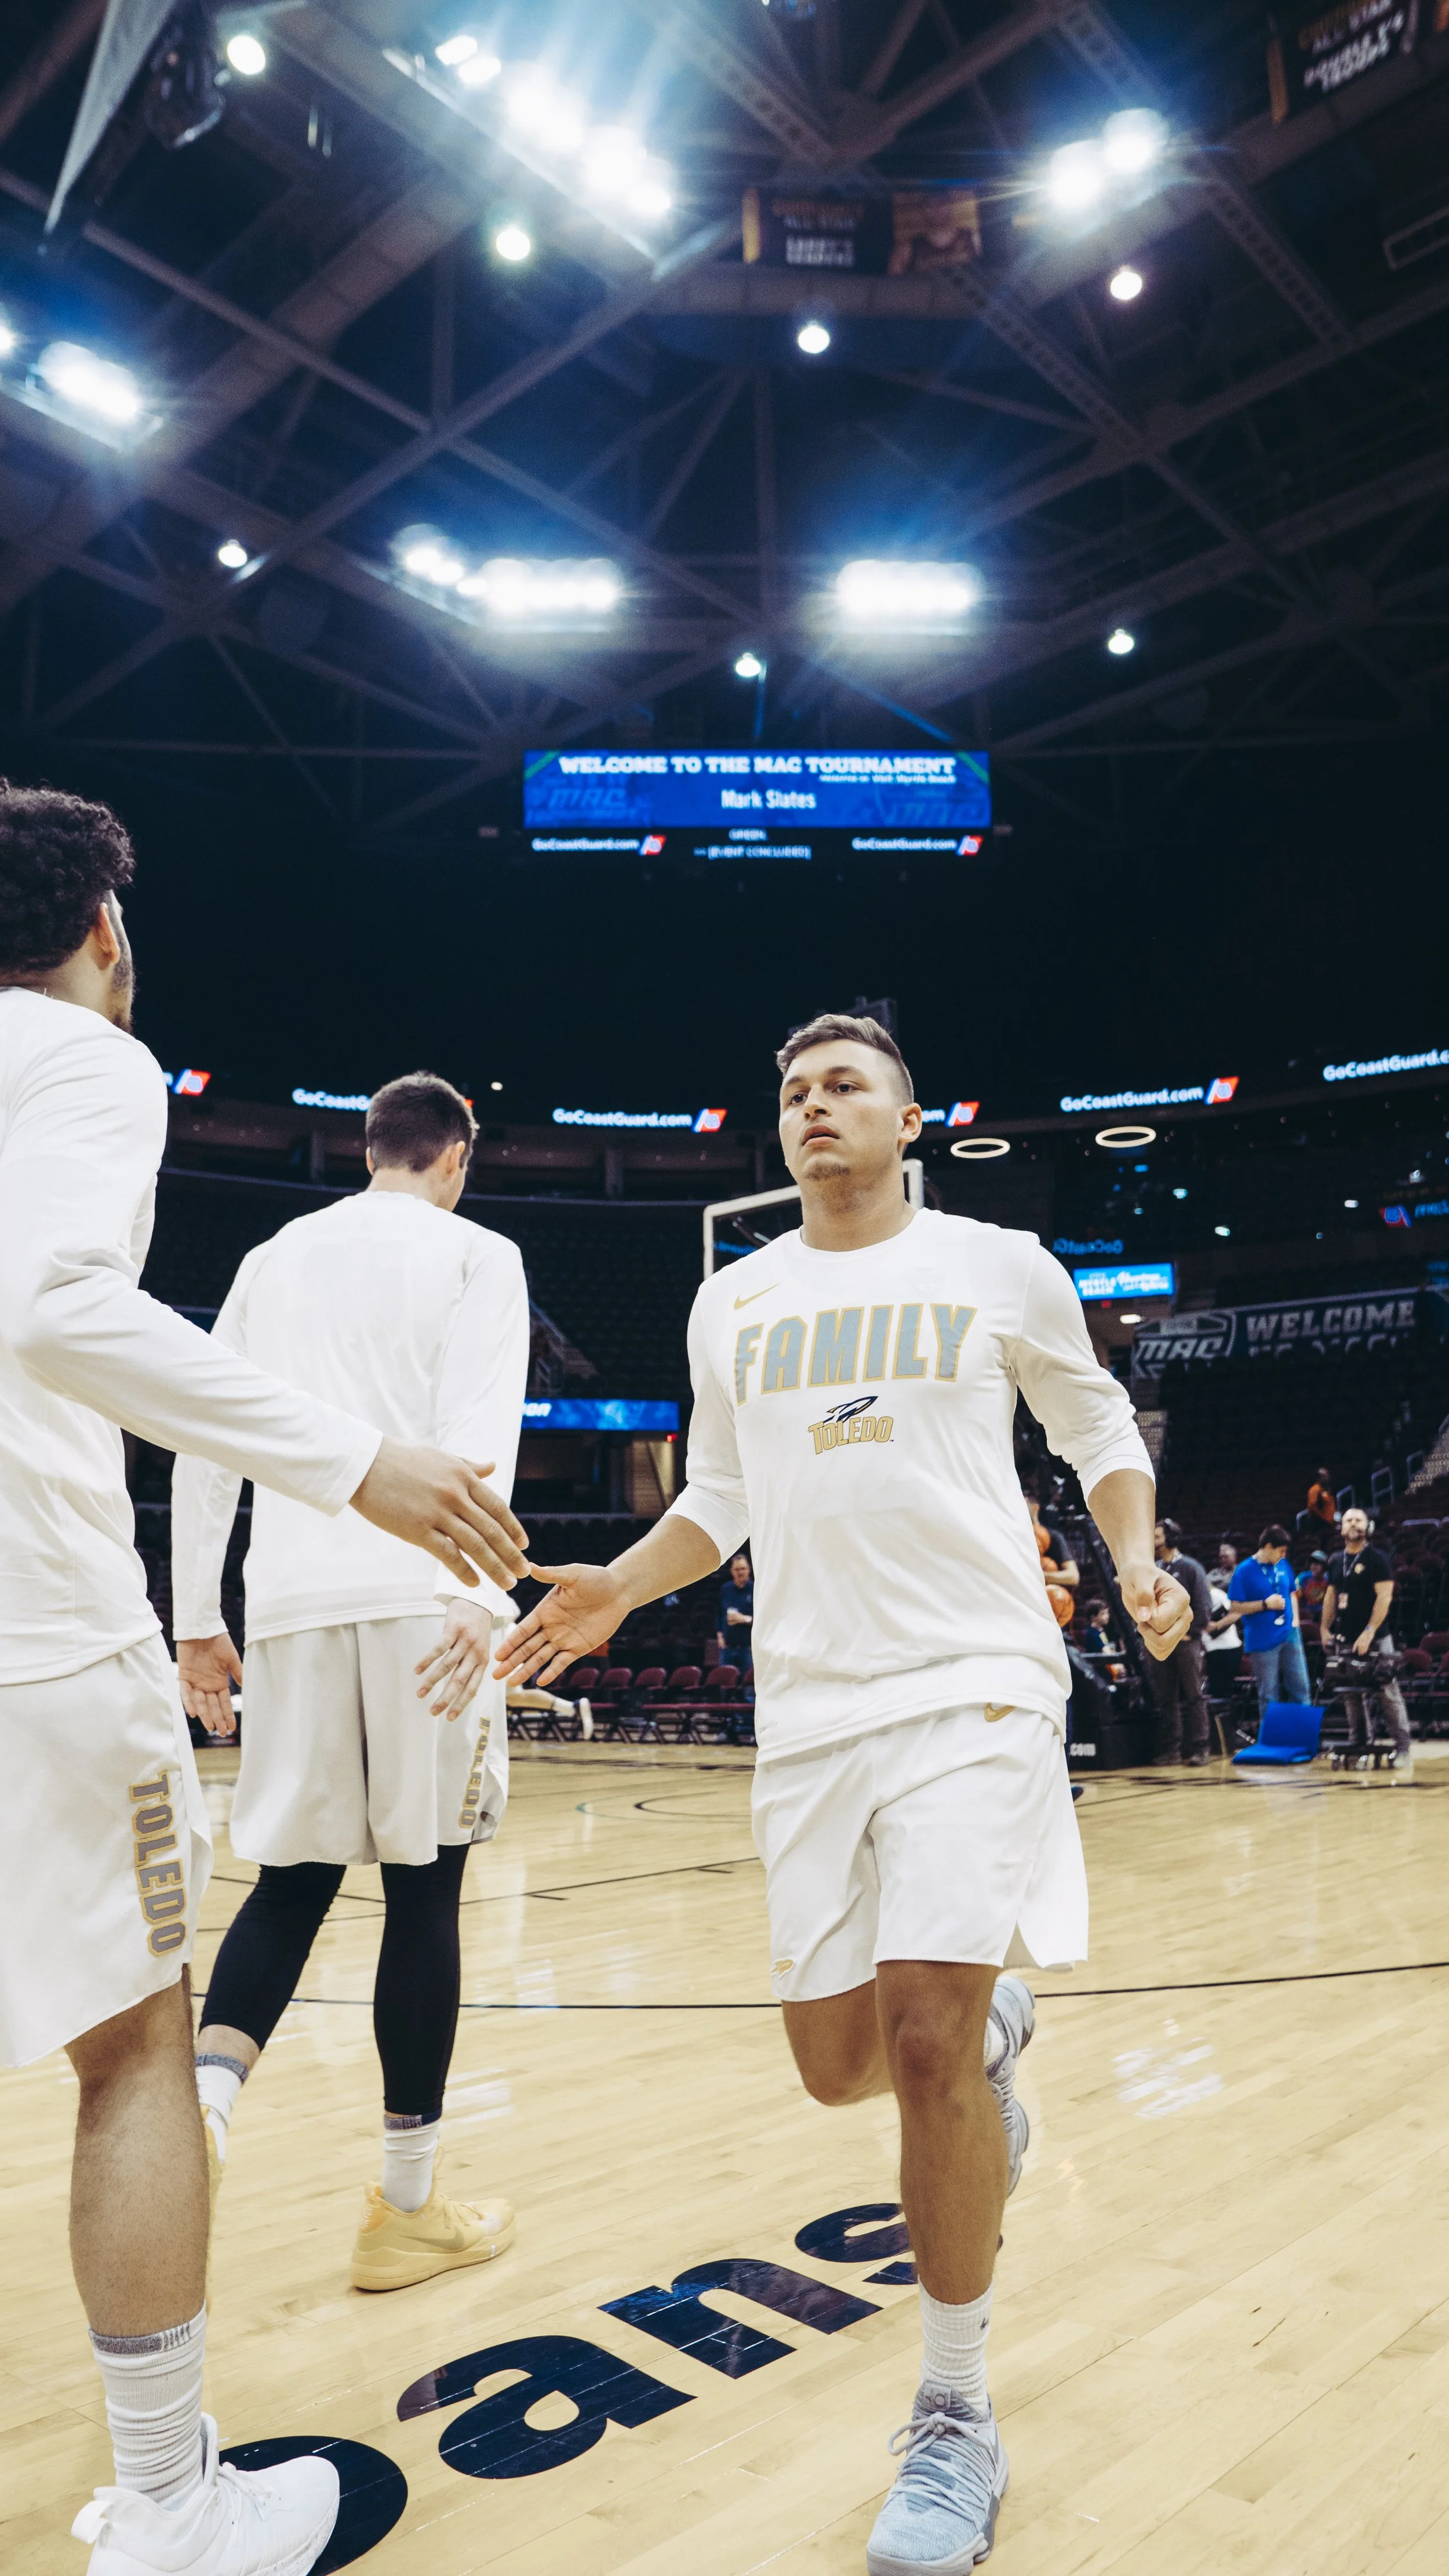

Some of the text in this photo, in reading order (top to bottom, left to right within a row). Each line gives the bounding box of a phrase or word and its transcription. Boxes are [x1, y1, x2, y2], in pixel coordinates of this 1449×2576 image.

[559, 756, 956, 775] WELCOME TO THE MAC TOURNAMENT
[722, 789, 763, 809] Mark
[531, 838, 639, 851] GoCoastGuard.com
[851, 837, 957, 851] GoCoastGuard.com
[1060, 1087, 1204, 1113] GoCoastGuard.com
[552, 1108, 693, 1127] GoCoastGuard.com
[1246, 1299, 1415, 1342] WELCOME
[734, 1303, 978, 1407] FAMILY
[1135, 1335, 1224, 1361] MAC
[807, 1416, 894, 1455] TOLEDO
[129, 1769, 188, 1958] TOLEDO
